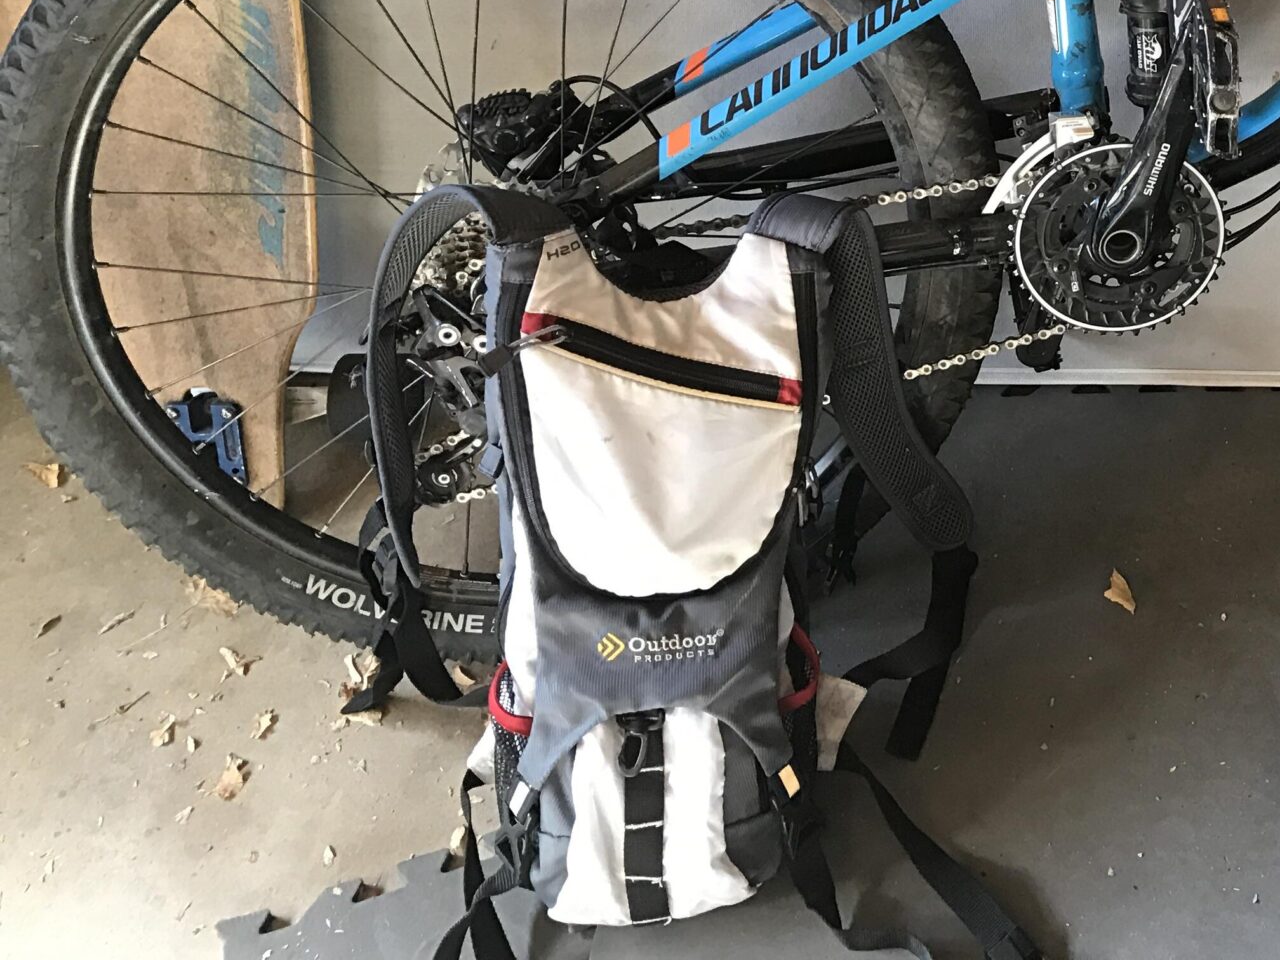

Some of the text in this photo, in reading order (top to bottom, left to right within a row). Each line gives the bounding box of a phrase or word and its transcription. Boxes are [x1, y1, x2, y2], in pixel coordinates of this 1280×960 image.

[1143, 142, 1172, 197] SHIMANO
[546, 240, 580, 261] H2O
[305, 573, 485, 634] WOLVRINE
[628, 634, 717, 652] Outdoor
[634, 648, 715, 663] PRODUCTS
